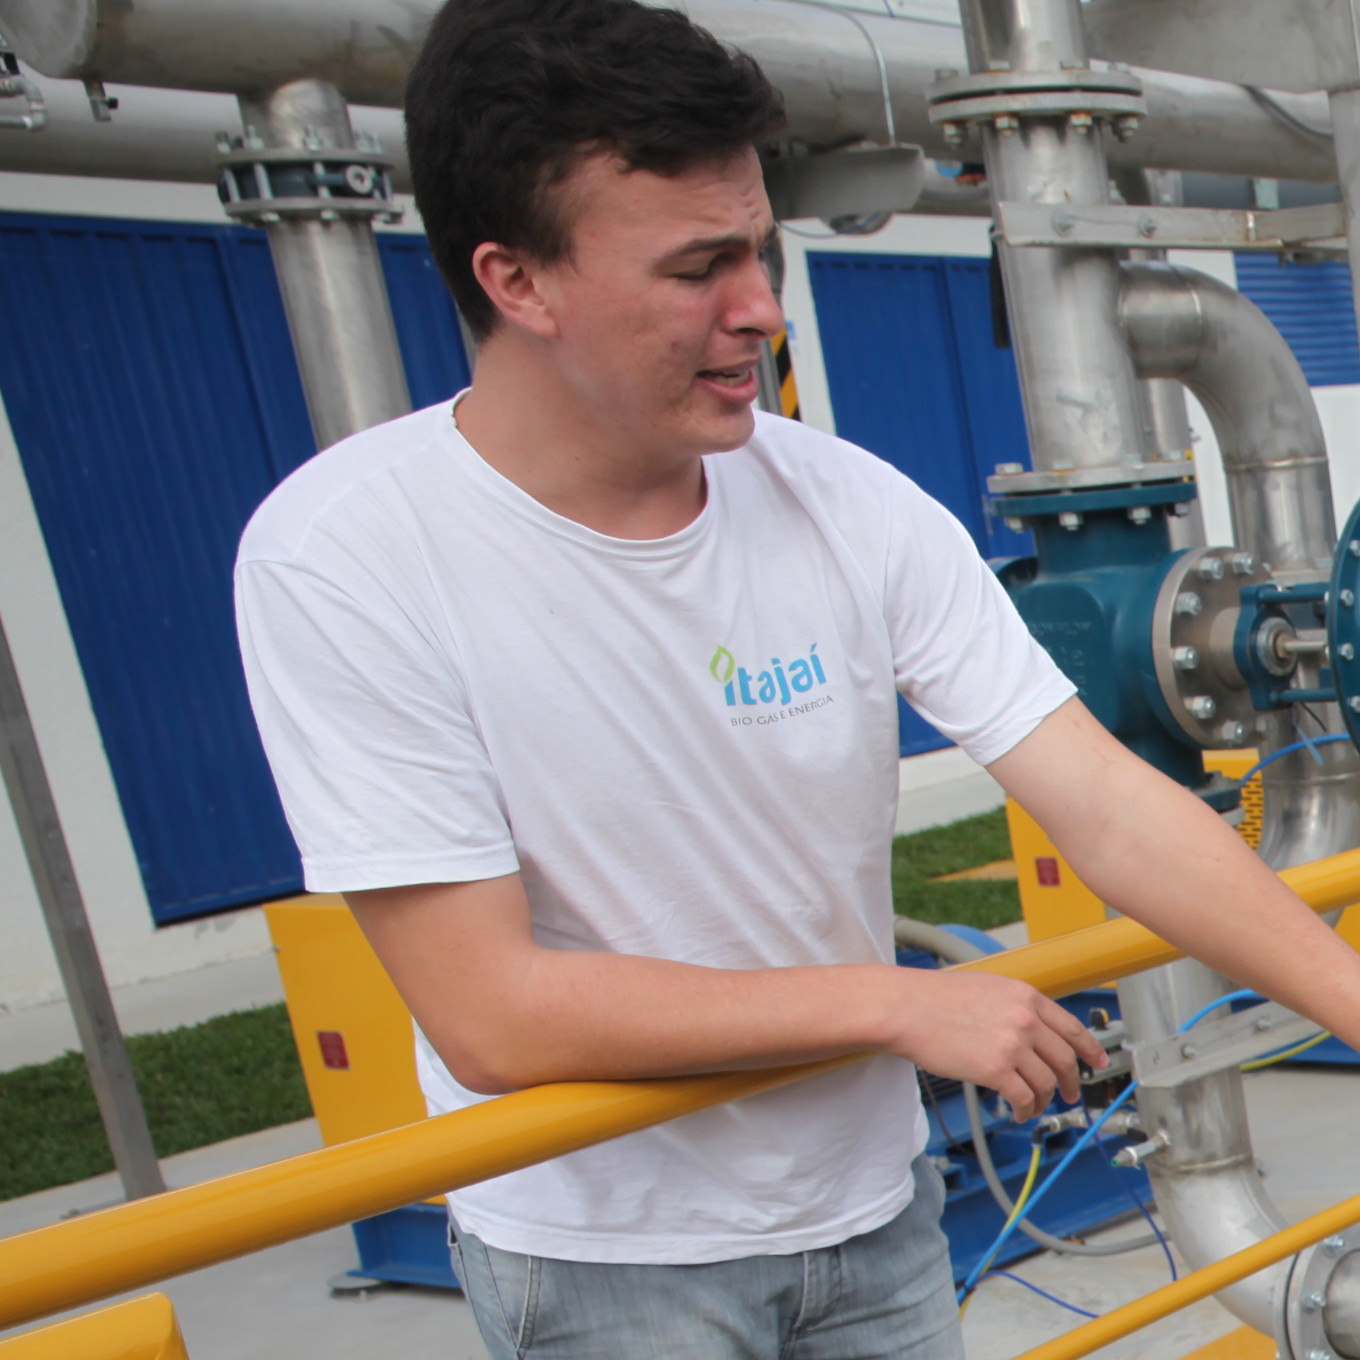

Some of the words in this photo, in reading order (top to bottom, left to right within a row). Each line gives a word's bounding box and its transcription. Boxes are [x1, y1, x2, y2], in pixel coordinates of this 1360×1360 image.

[731, 717, 753, 727] BIO
[780, 710, 786, 720] E
[788, 694, 835, 717] ENERGIA
